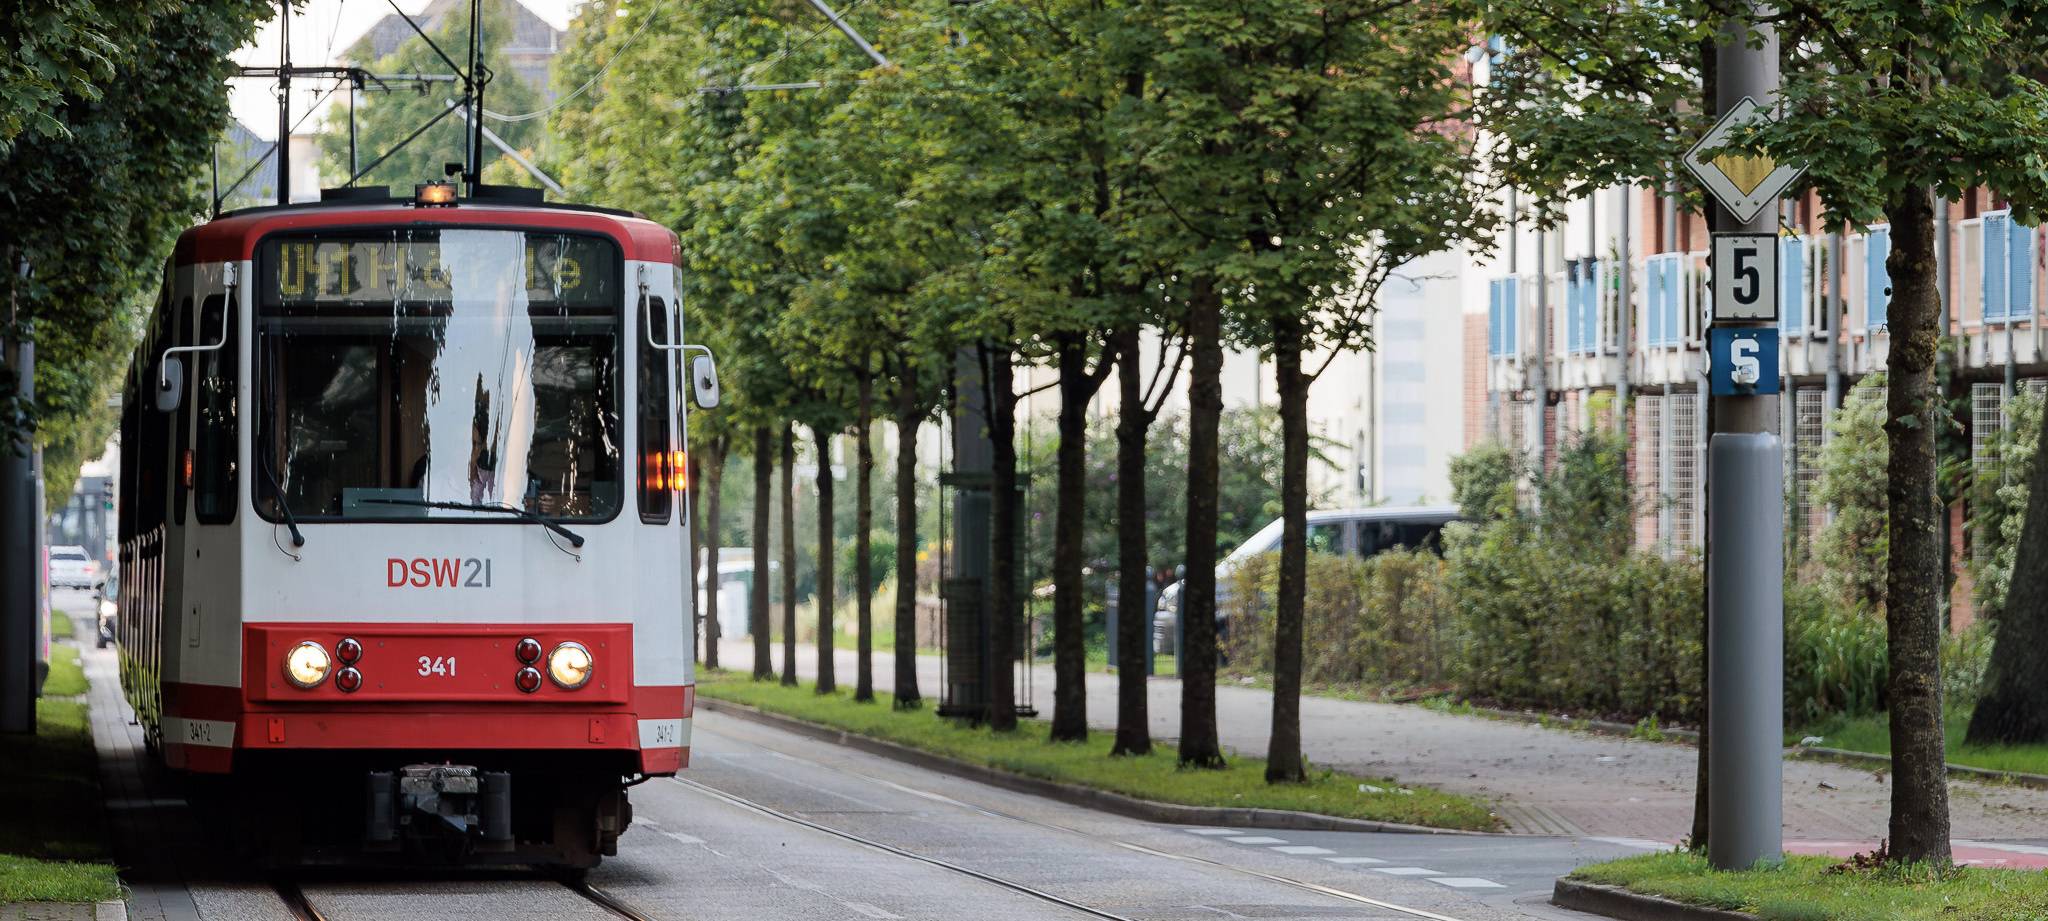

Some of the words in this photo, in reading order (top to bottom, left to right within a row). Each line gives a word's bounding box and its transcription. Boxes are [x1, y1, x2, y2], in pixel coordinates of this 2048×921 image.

[281, 243, 349, 296] U41
[1732, 247, 1760, 305] 5
[1730, 338, 1760, 384] S
[417, 655, 457, 677] 341
